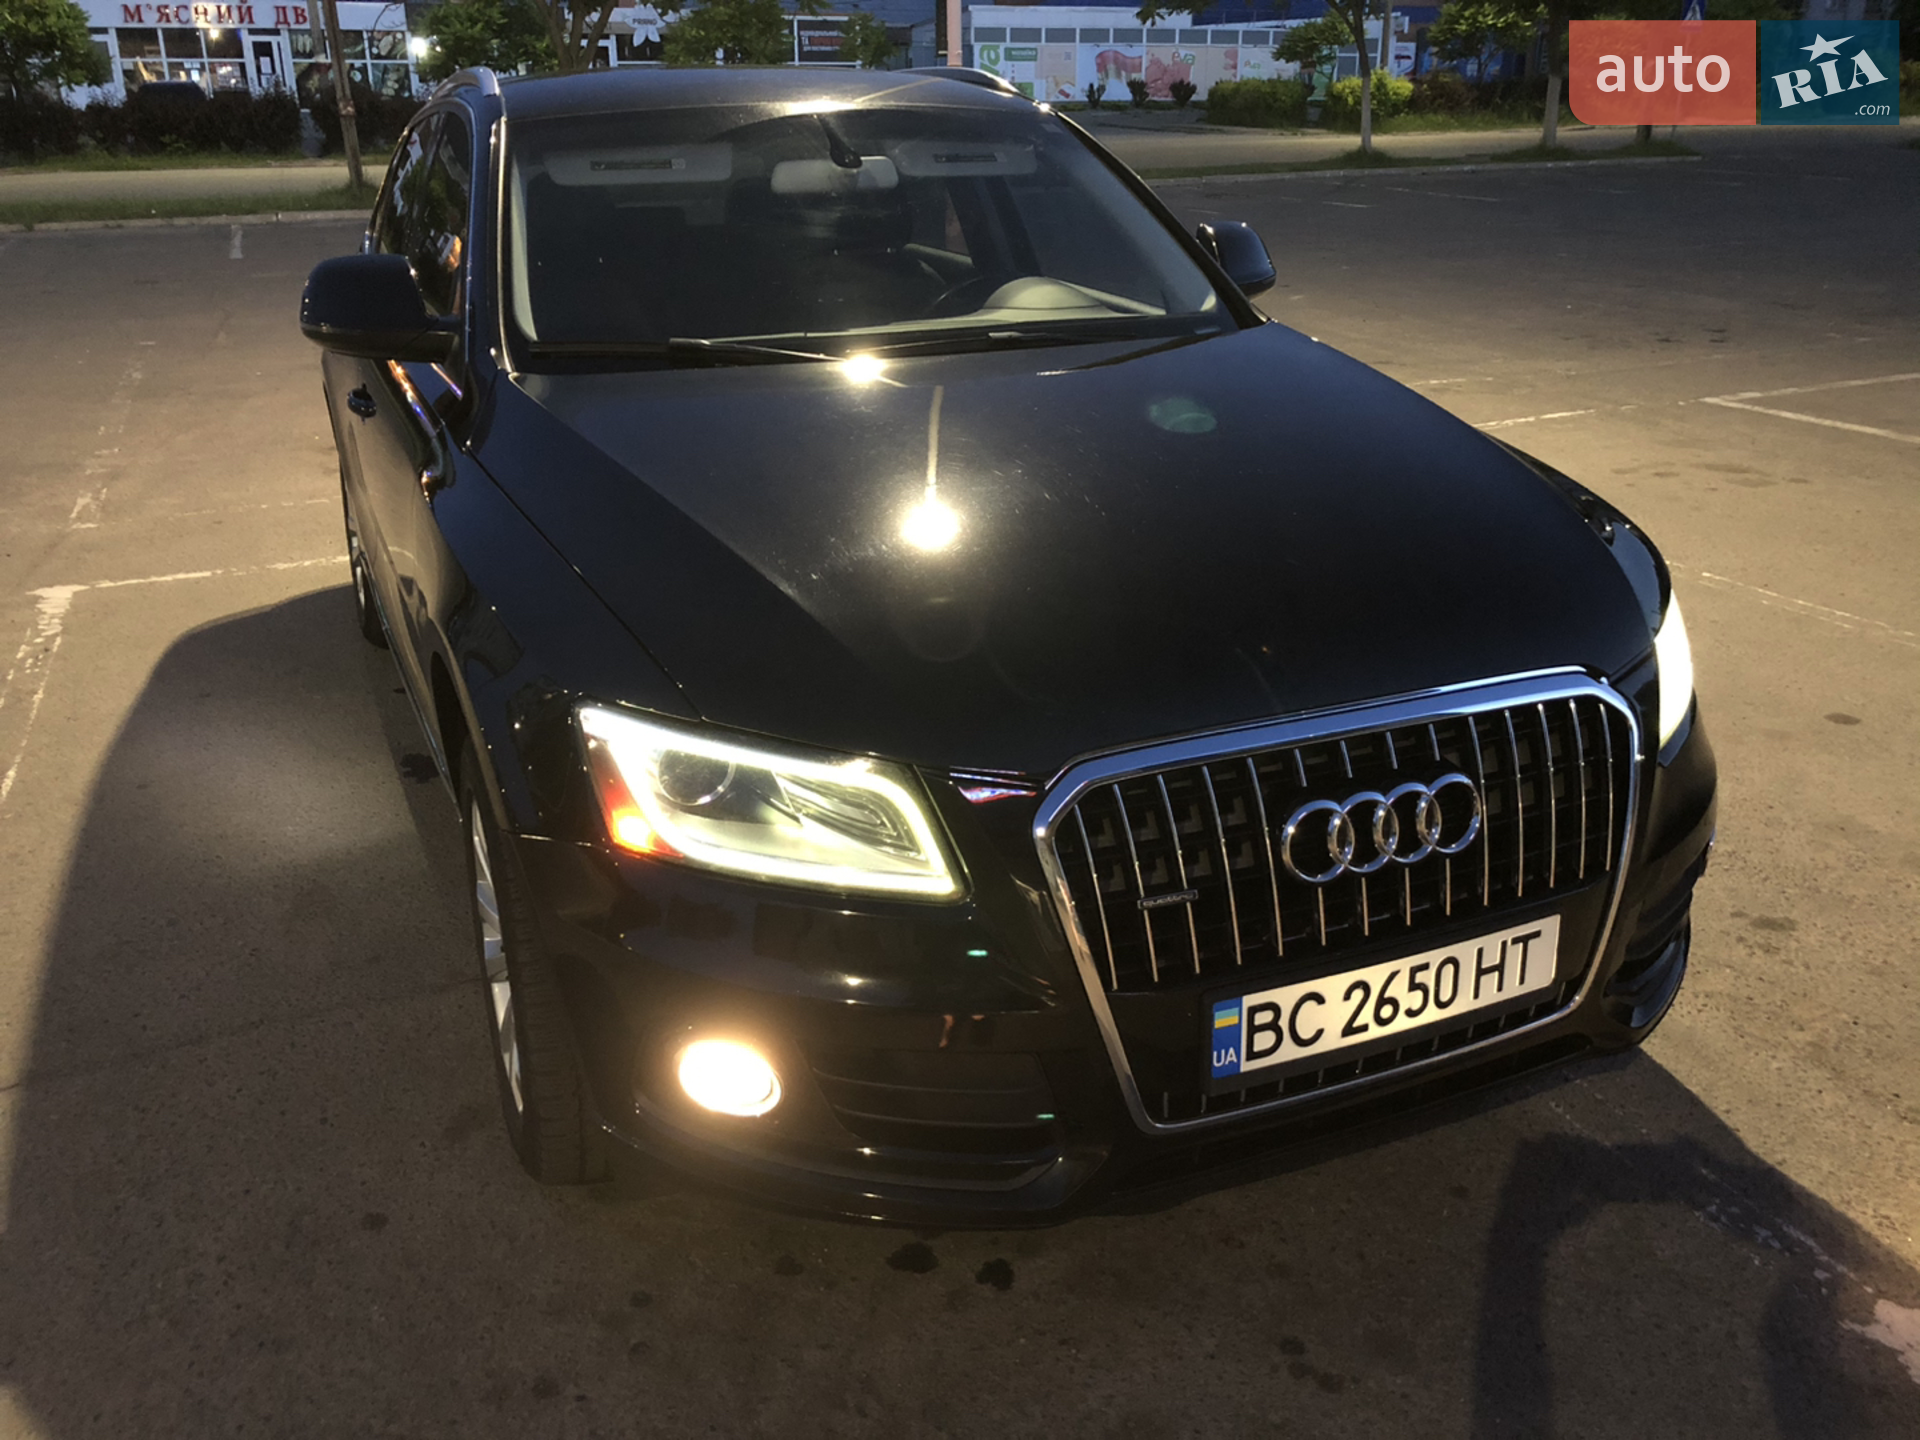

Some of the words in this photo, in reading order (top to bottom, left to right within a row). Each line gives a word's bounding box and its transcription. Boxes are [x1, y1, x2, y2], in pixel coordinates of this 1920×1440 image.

[1245, 991, 1326, 1062] BC
[1341, 956, 1460, 1039] 2650
[1472, 929, 1542, 1000] HT
[1212, 1047, 1238, 1067] UA
